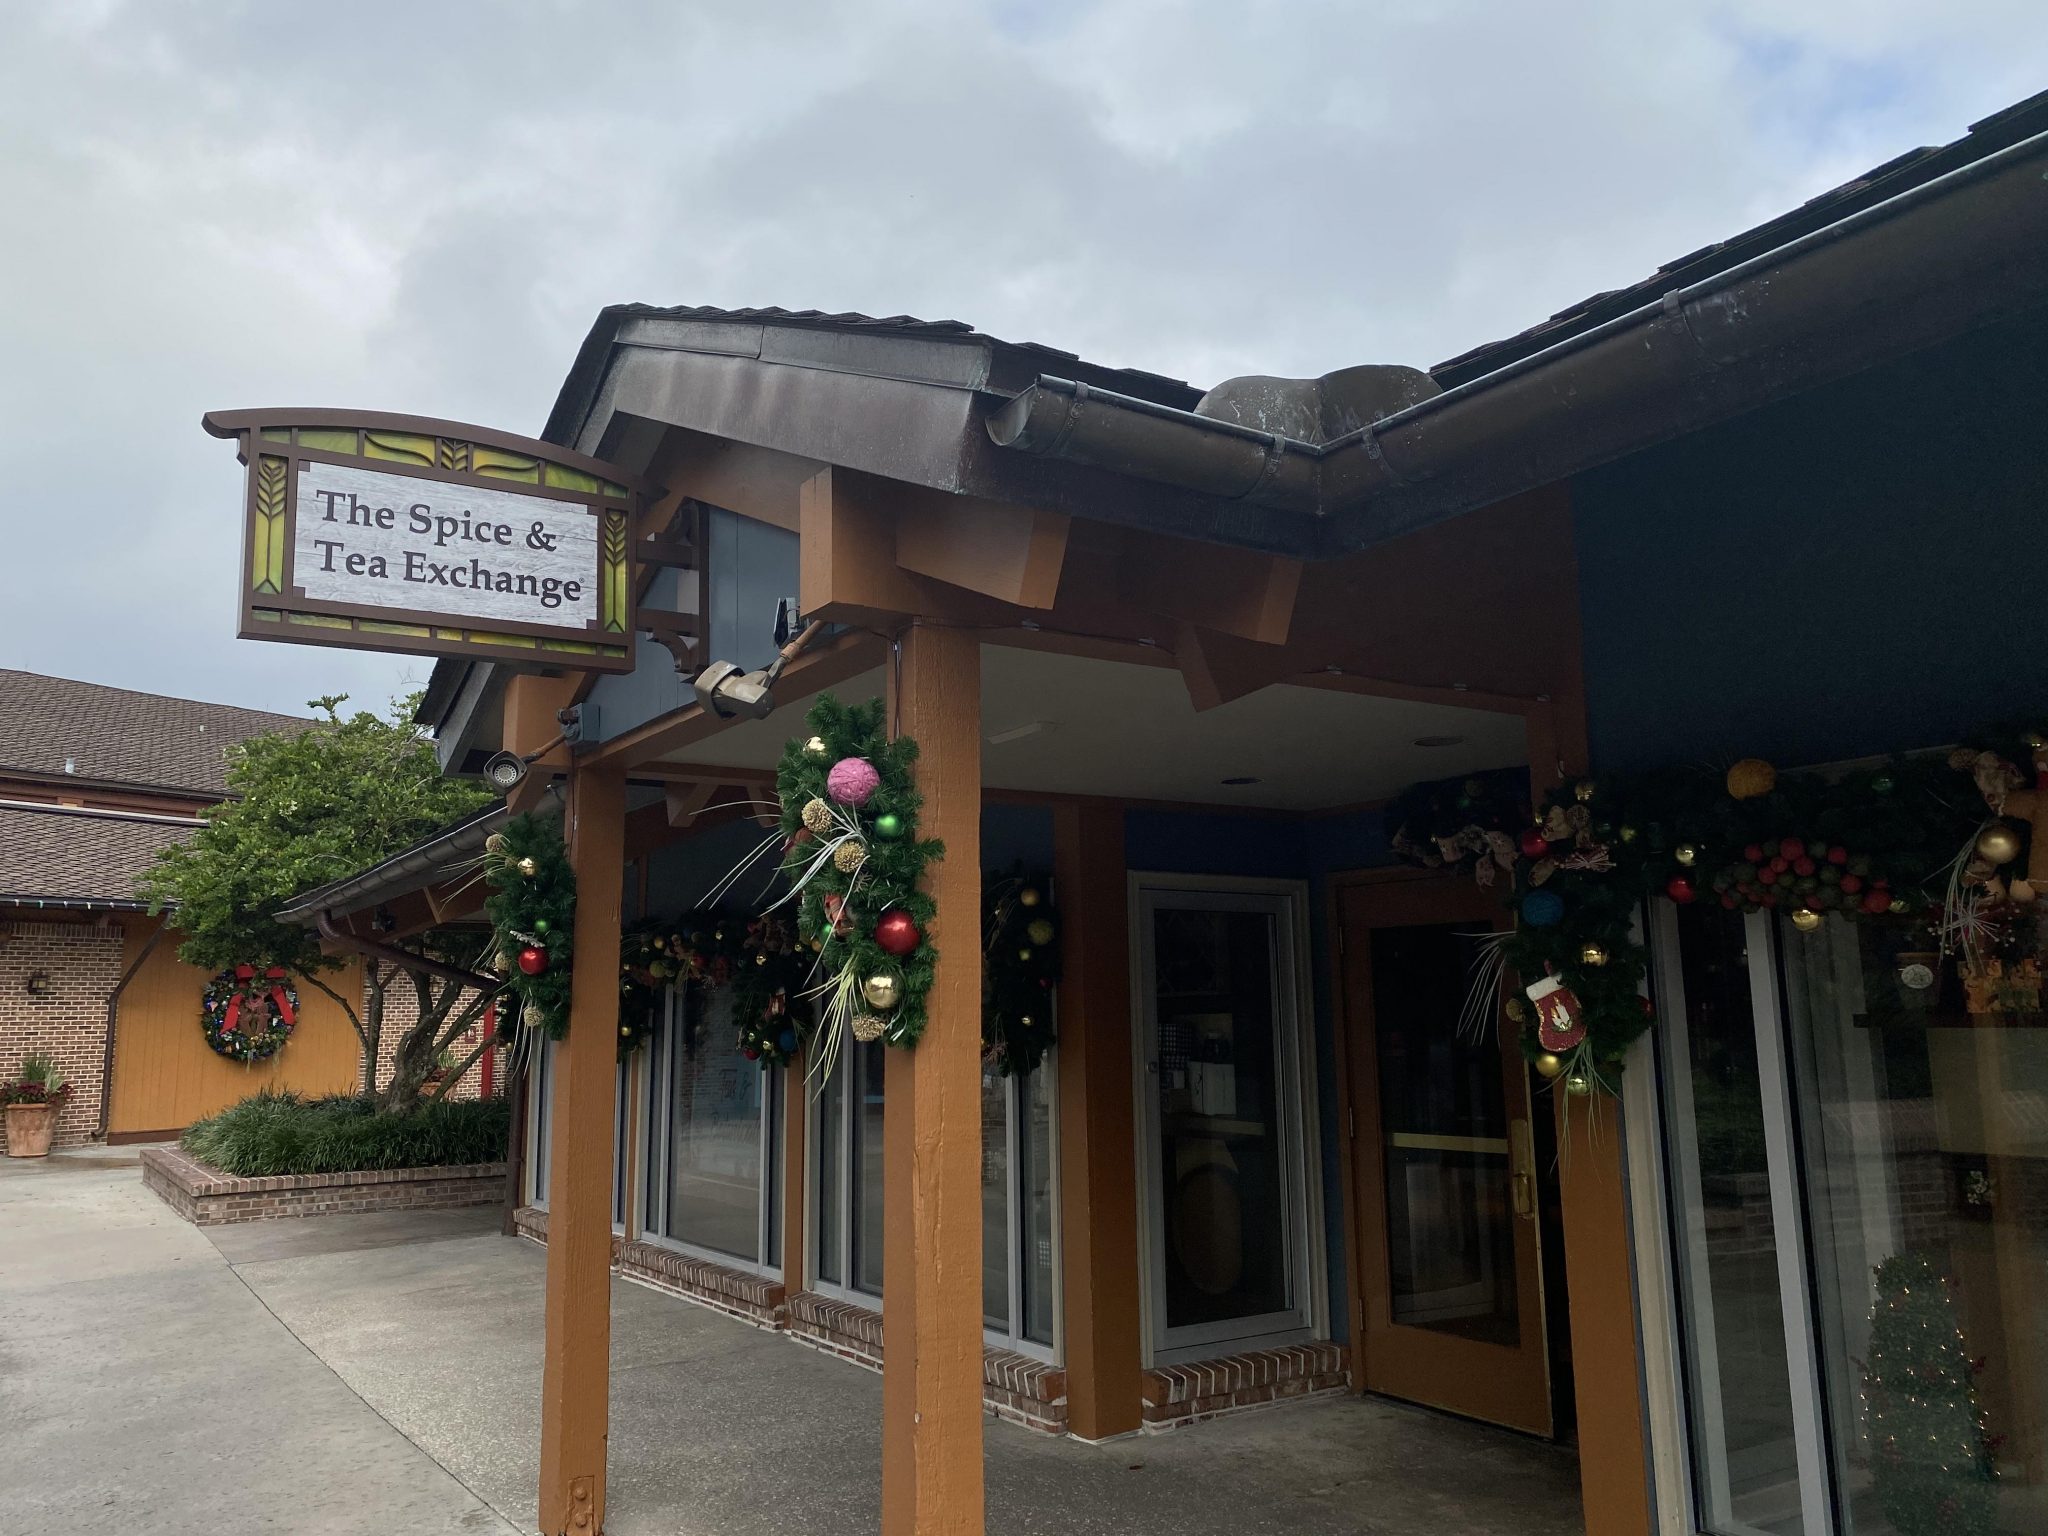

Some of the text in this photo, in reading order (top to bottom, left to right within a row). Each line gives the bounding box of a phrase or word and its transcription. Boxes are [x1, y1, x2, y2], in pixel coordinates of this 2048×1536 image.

[317, 490, 556, 552] The Spice &
[315, 540, 388, 578] Tea
